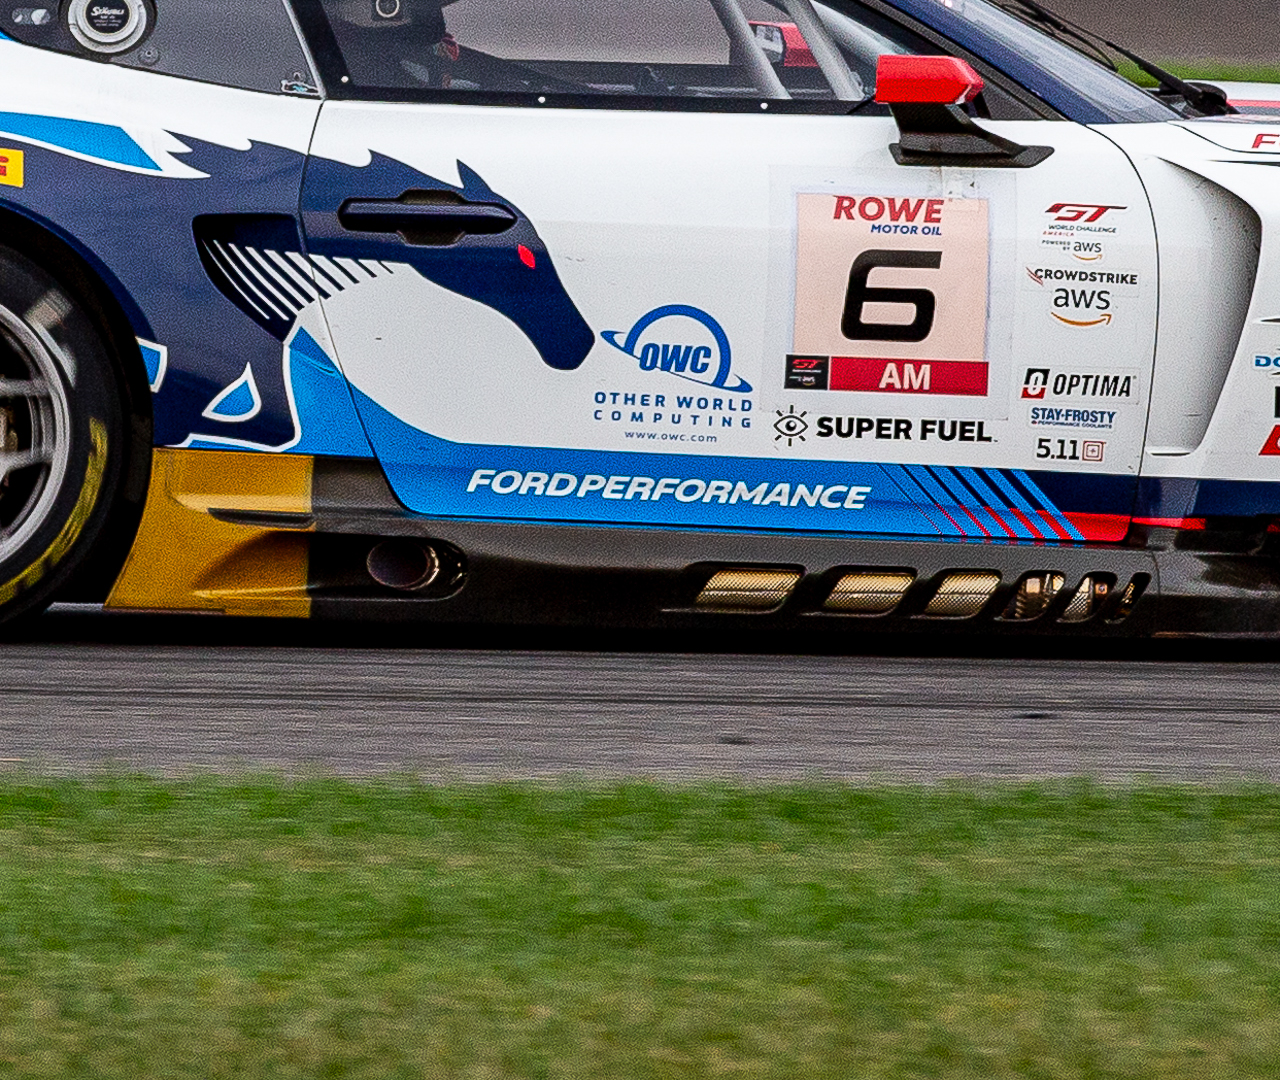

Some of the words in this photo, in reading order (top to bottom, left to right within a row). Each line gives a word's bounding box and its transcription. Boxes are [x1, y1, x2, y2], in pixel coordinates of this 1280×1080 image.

[833, 195, 944, 223] ROWE
[870, 224, 918, 235] MOTOR
[921, 225, 942, 236] OIL
[1076, 225, 1117, 233] CHALLENGE
[1073, 241, 1102, 253] aws
[1034, 268, 1138, 285] CROWDSTRIKE
[841, 249, 942, 342] 6
[1053, 288, 1110, 310] aws
[639, 343, 711, 373] OWC
[878, 362, 931, 390] AM
[1052, 374, 1132, 397] OPTIMA
[594, 392, 666, 407] OTHER
[676, 396, 752, 412] WORLD
[593, 410, 751, 428] COMPUTING
[816, 416, 912, 440] SUPER
[920, 420, 993, 442] FUEL
[624, 431, 718, 442] www.owc.com
[1037, 438, 1079, 460] 5.11
